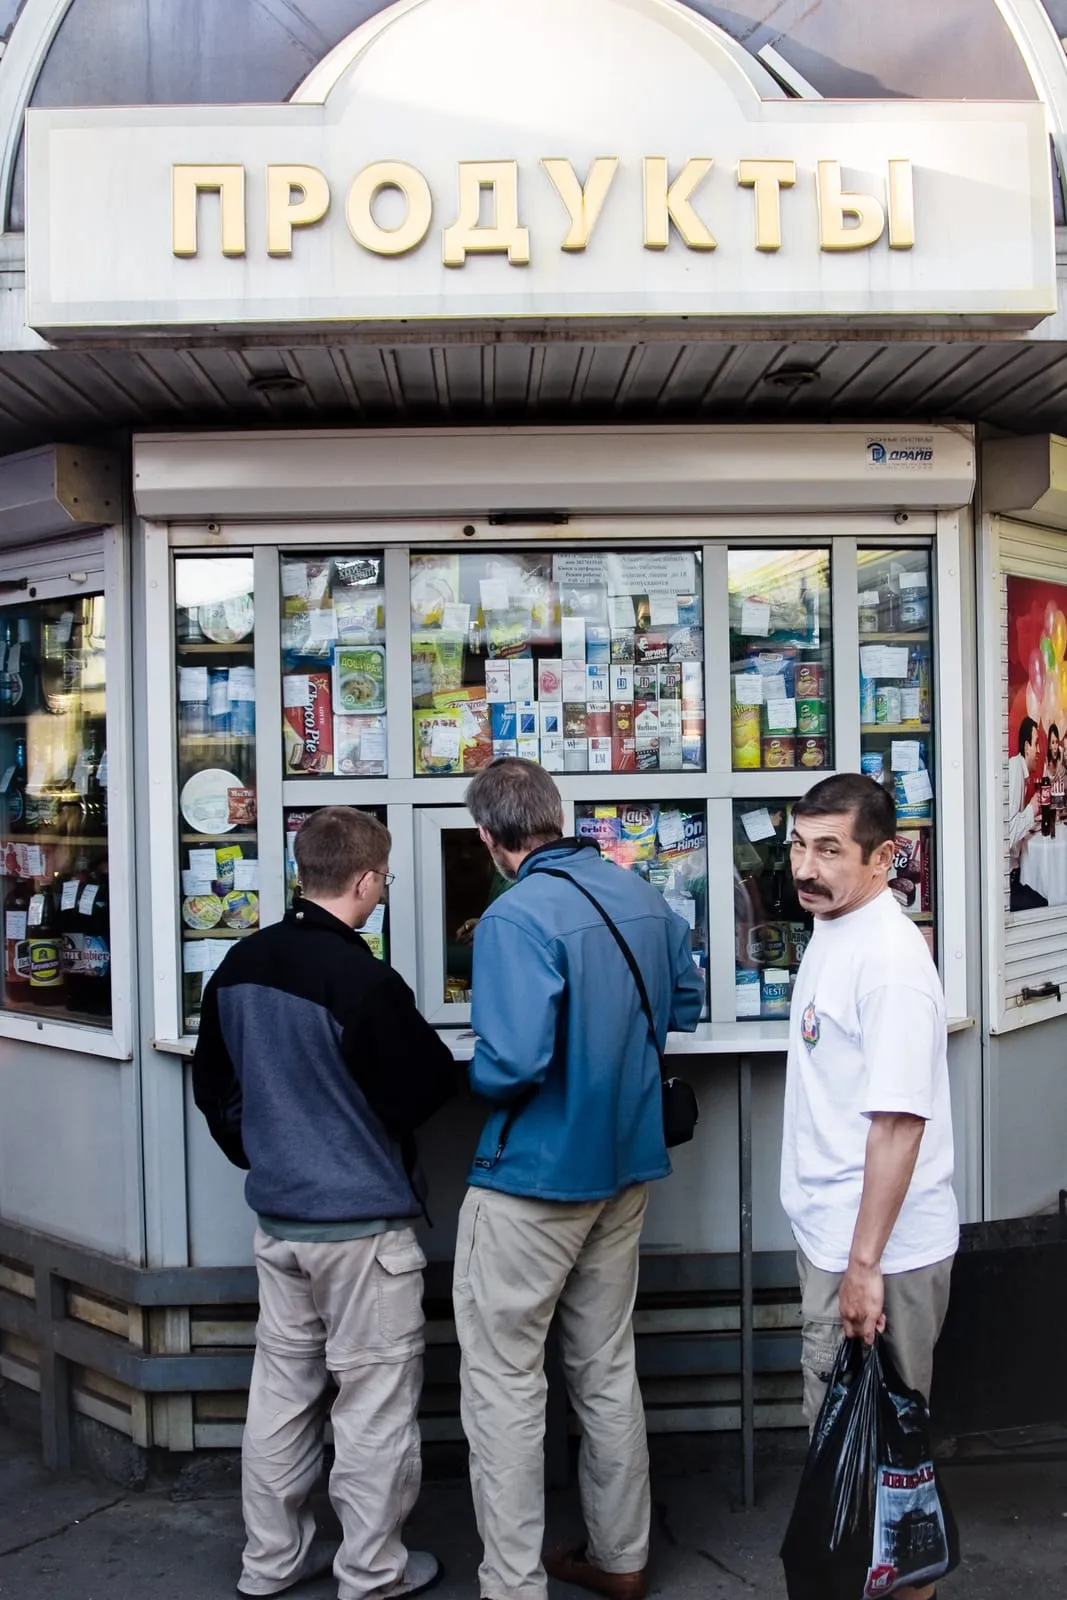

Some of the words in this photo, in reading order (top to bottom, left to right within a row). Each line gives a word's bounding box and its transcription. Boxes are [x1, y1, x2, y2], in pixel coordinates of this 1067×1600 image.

[171, 157, 917, 267] ПРОДУКТЫ
[888, 449, 934, 461] ДРАЙВ
[306, 728, 320, 753] Pie
[581, 824, 607, 833] Orbit
[677, 835, 705, 851] Rings
[763, 985, 787, 996] NESTL
